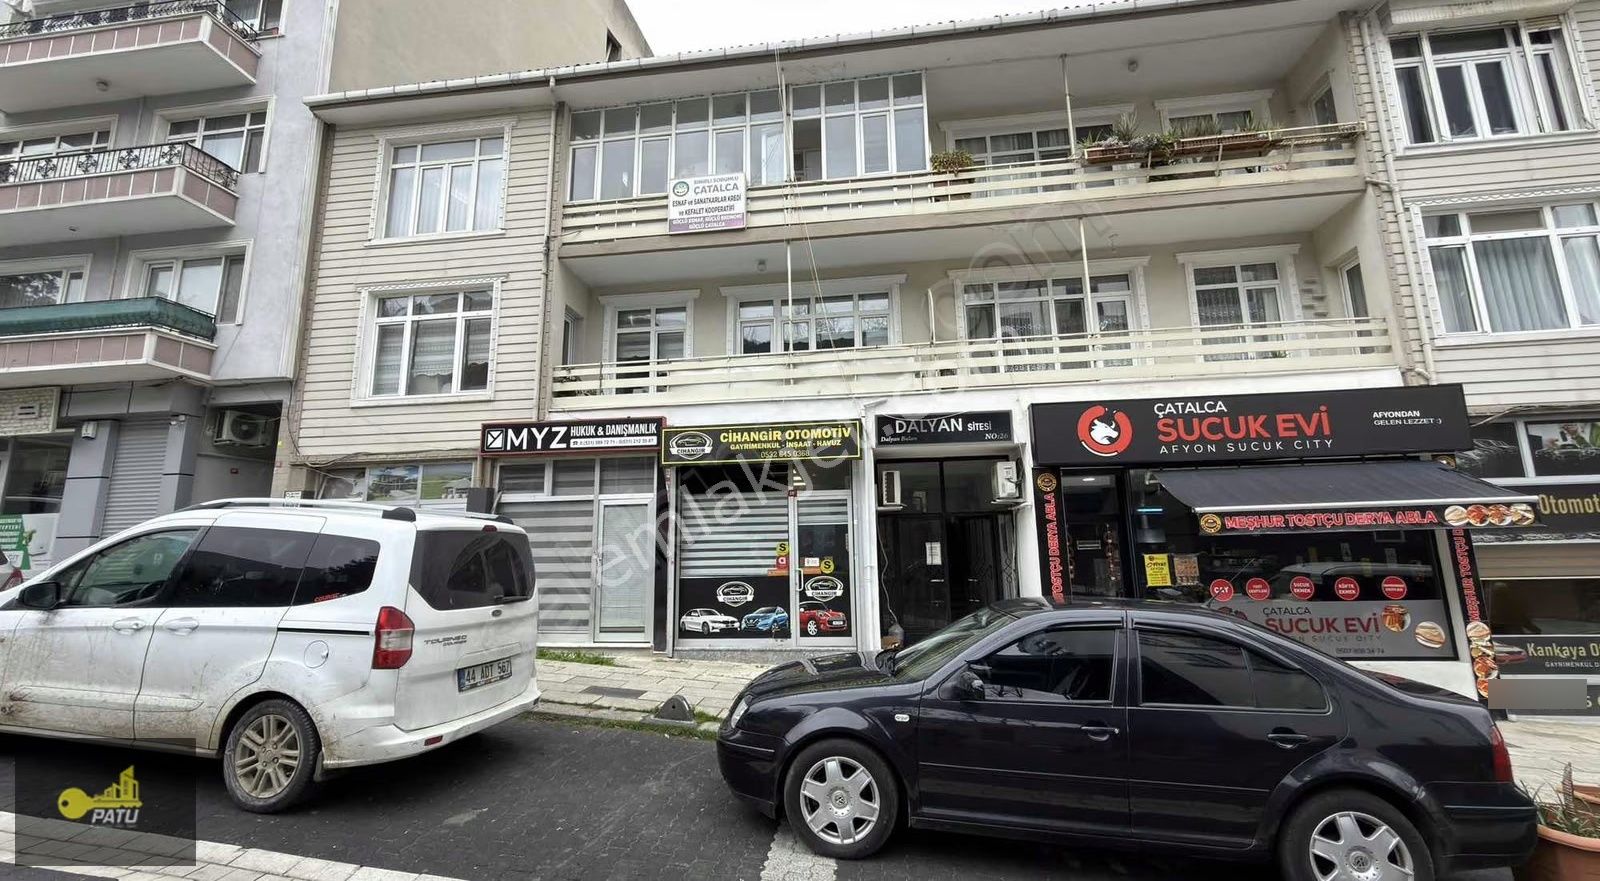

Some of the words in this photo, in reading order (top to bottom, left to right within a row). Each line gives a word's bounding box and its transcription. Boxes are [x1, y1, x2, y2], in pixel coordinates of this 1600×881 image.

[694, 183, 739, 195] ÇATALCA
[1154, 401, 1227, 418] ÇATALCA
[1373, 410, 1420, 418] AFYONDAN
[570, 425, 596, 437] HUKUK
[597, 427, 604, 436] &
[605, 423, 657, 436] DANIŞMANLIK
[895, 418, 962, 433] DALYAN
[967, 420, 992, 431] SİTESİ
[1156, 414, 1271, 442] SUCUK
[1275, 404, 1332, 438] EVİ
[507, 426, 567, 450] MYZ
[720, 428, 781, 443] CİHANGİR
[785, 425, 851, 440] OTOMOTİV
[881, 435, 900, 443] Dalyan
[817, 439, 841, 447] HAVUZ
[1160, 443, 1216, 454] AFYON
[1227, 441, 1283, 452] SUCUK
[1294, 439, 1333, 449] CITY
[1044, 492, 1057, 521] ABLA
[1224, 514, 1285, 530] MEŞHUR
[1286, 513, 1345, 529] TOSTÇU
[1345, 511, 1393, 525] DERYA
[1396, 510, 1437, 524] ABLA
[1047, 521, 1060, 557] DERYA
[1453, 536, 1473, 578] TOSTÇU
[1461, 577, 1481, 622] MEŞHUR
[1263, 607, 1311, 617] ÇATALCA
[1265, 617, 1340, 633] SUCUK
[1344, 612, 1380, 633] EVİ
[424, 635, 467, 645] TOURNEO
[1526, 643, 1586, 660] Kankaya
[1590, 643, 1600, 657] O
[466, 669, 476, 683] 44
